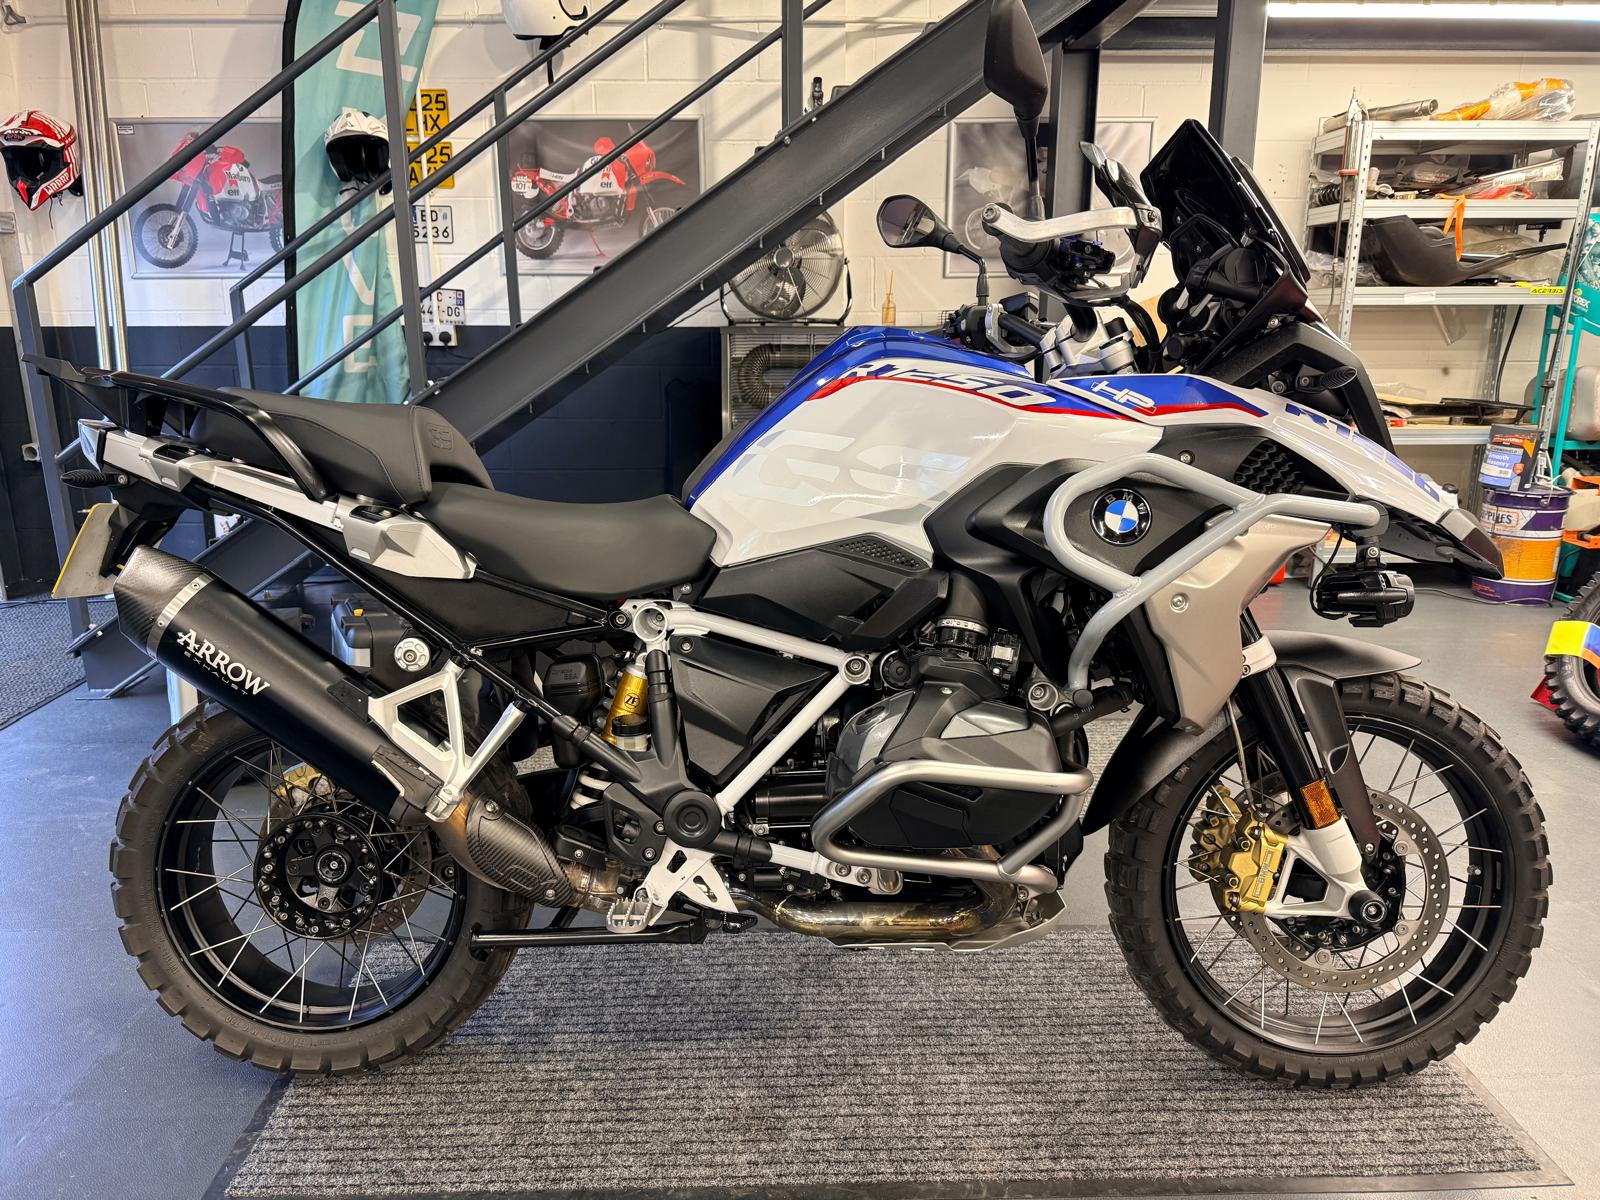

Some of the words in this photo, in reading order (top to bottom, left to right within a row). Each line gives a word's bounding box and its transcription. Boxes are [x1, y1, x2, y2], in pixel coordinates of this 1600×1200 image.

[1091, 380, 1156, 413] HP
[732, 429, 971, 517] GS
[1104, 491, 1148, 515] BMW
[177, 628, 271, 696] ARROW
[184, 651, 248, 695] EXHAUST
[625, 695, 640, 706] ZF
